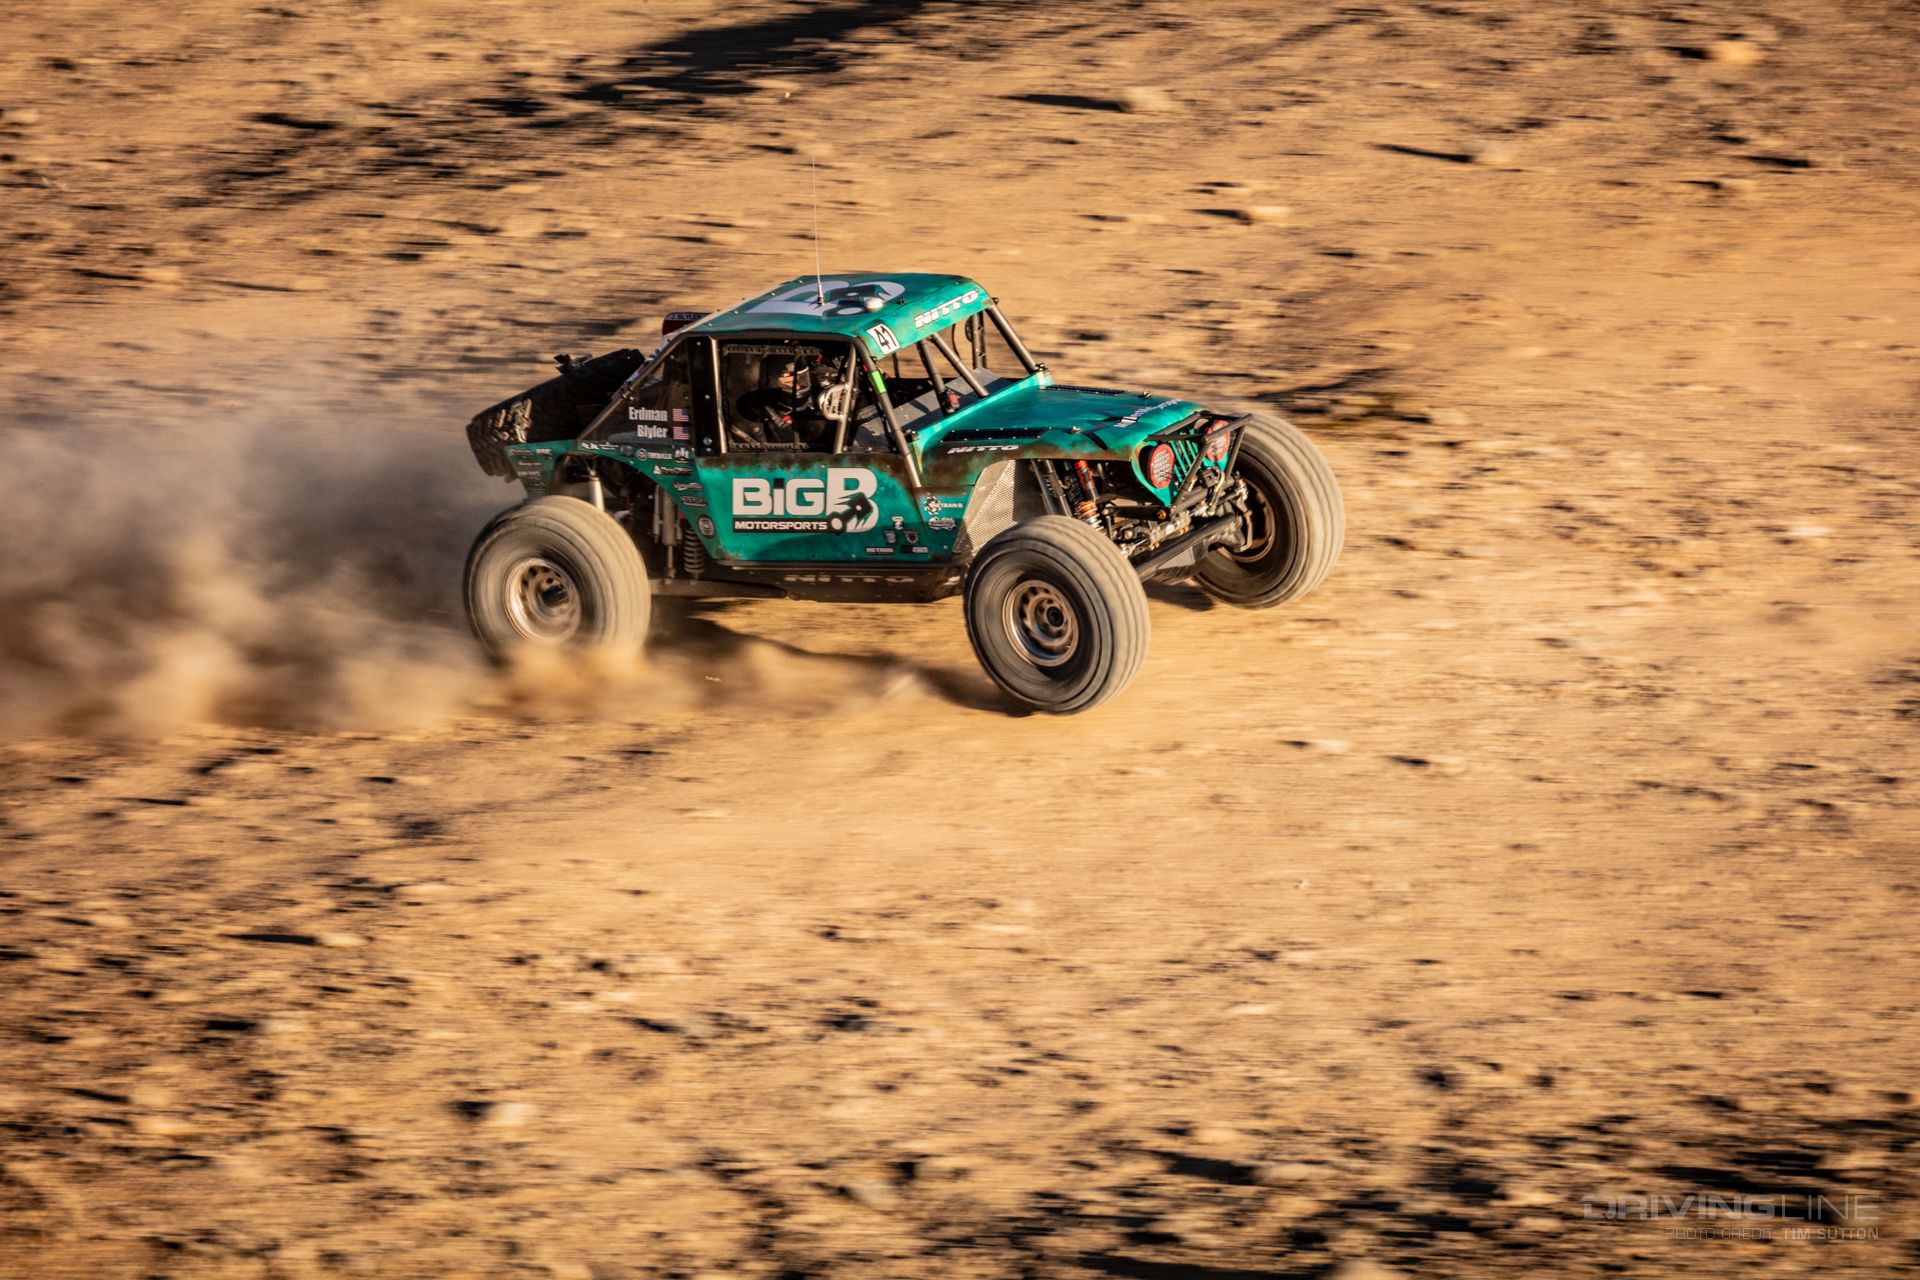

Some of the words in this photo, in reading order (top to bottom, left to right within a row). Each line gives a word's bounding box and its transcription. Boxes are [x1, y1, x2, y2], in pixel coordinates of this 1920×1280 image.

[914, 288, 979, 329] NITTO
[873, 325, 898, 350] 41
[628, 406, 668, 422] Erdman
[636, 424, 668, 440] Blyler
[946, 444, 1020, 455] NITTO
[734, 520, 828, 531] MOTORSPORTS
